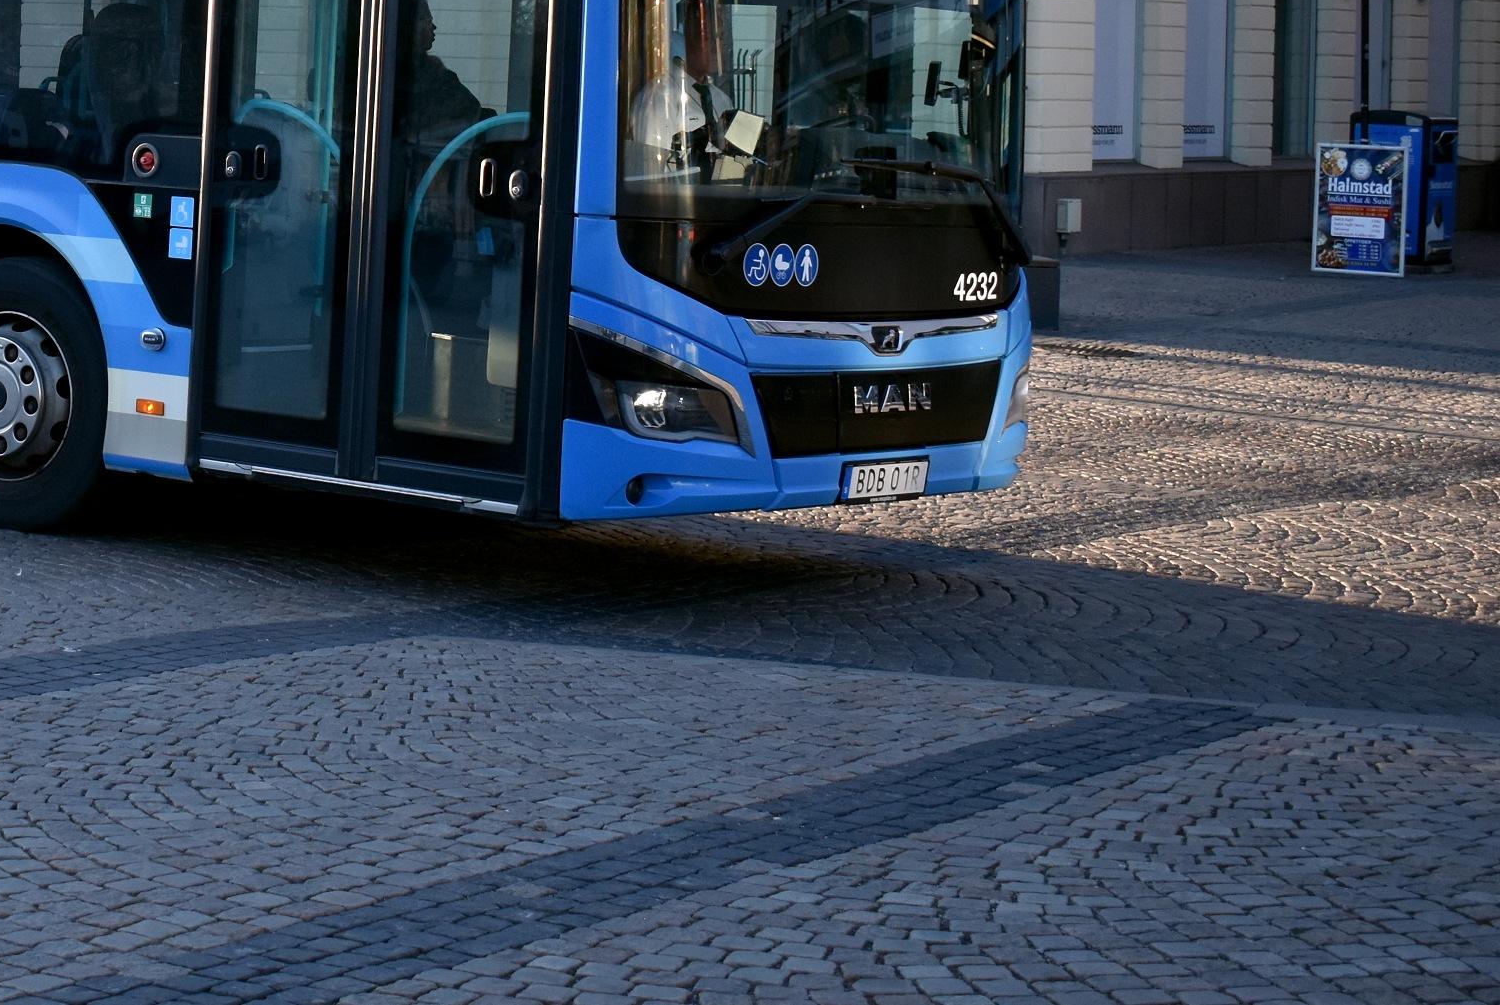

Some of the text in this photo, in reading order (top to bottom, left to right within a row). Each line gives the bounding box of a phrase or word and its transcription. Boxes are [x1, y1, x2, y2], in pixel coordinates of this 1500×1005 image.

[1328, 177, 1392, 194] Halmstad
[953, 271, 998, 302] 4232
[853, 382, 932, 414] MAN
[856, 468, 886, 493] BDB
